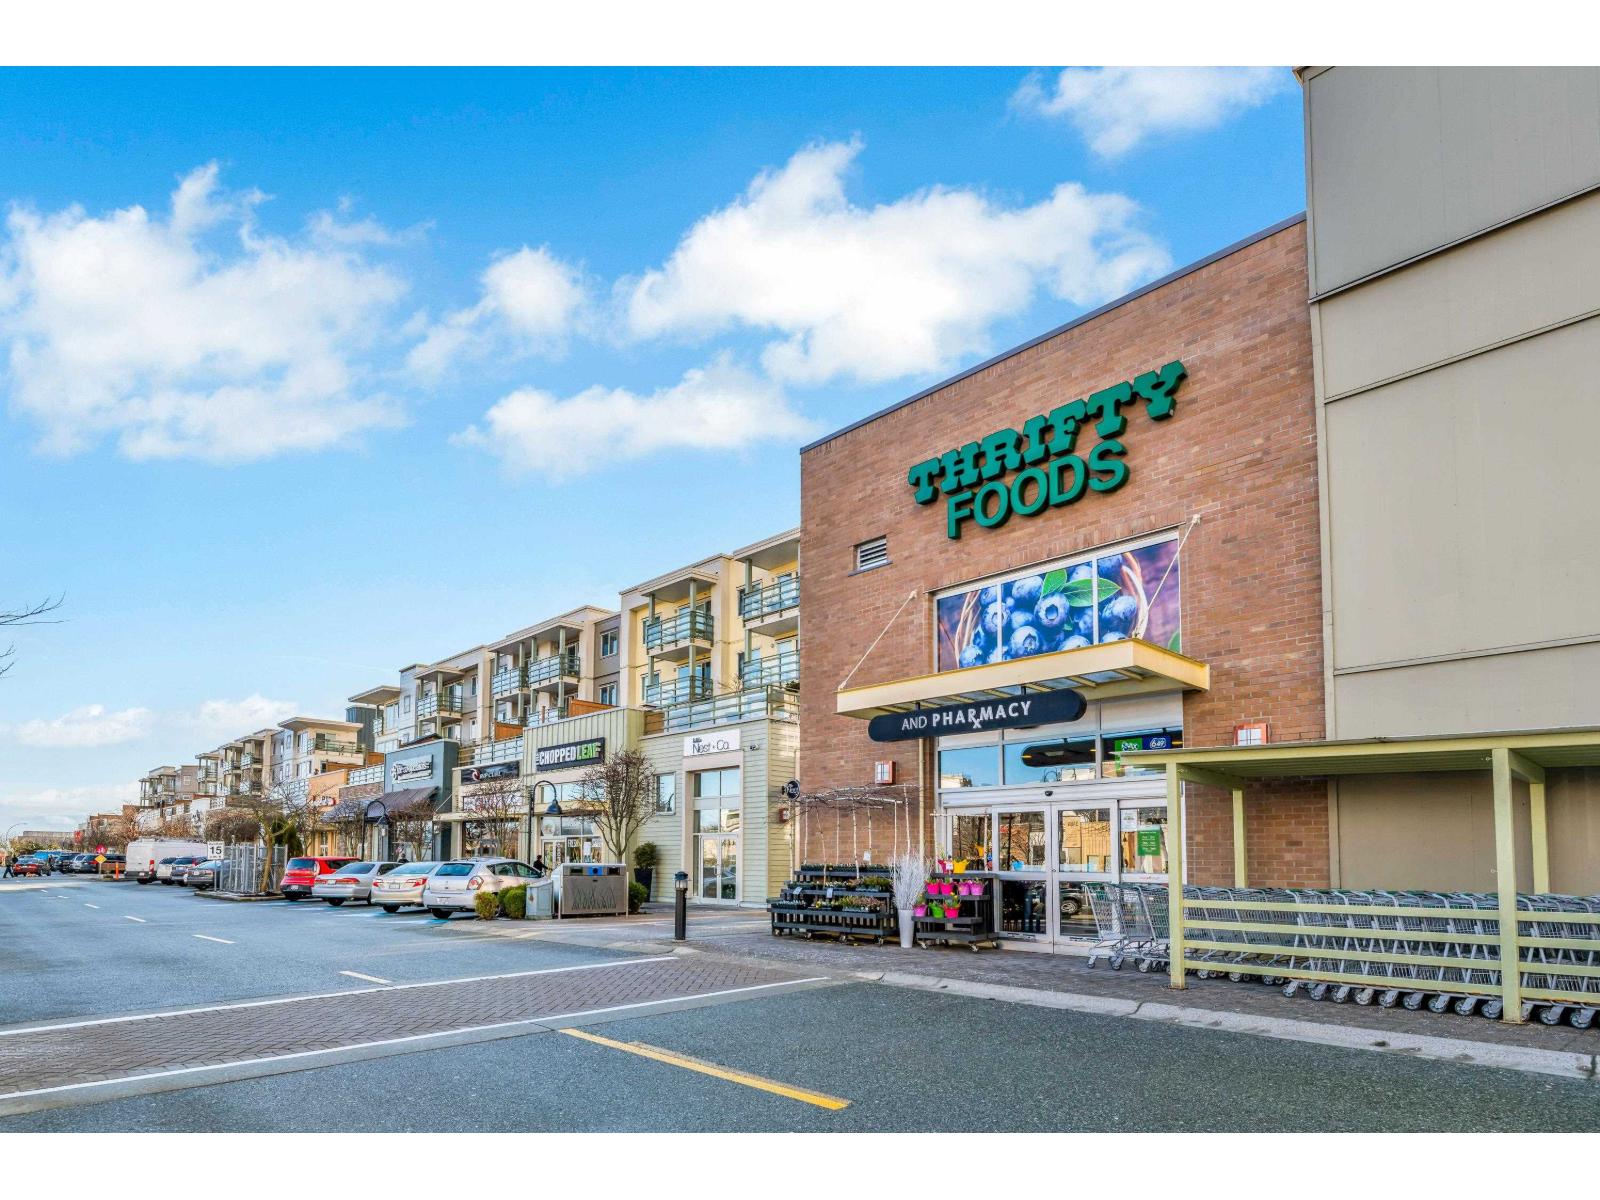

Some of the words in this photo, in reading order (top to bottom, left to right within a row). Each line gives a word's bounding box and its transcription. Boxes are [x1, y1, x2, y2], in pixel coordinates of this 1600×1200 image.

[908, 360, 1188, 505] THRIFTY
[947, 439, 1130, 540] FOODS
[901, 716, 927, 731] AND
[932, 701, 1032, 727] PHARMACY
[539, 746, 577, 766] CHOPPED
[576, 742, 602, 761] LEAF
[209, 846, 222, 855] 15
